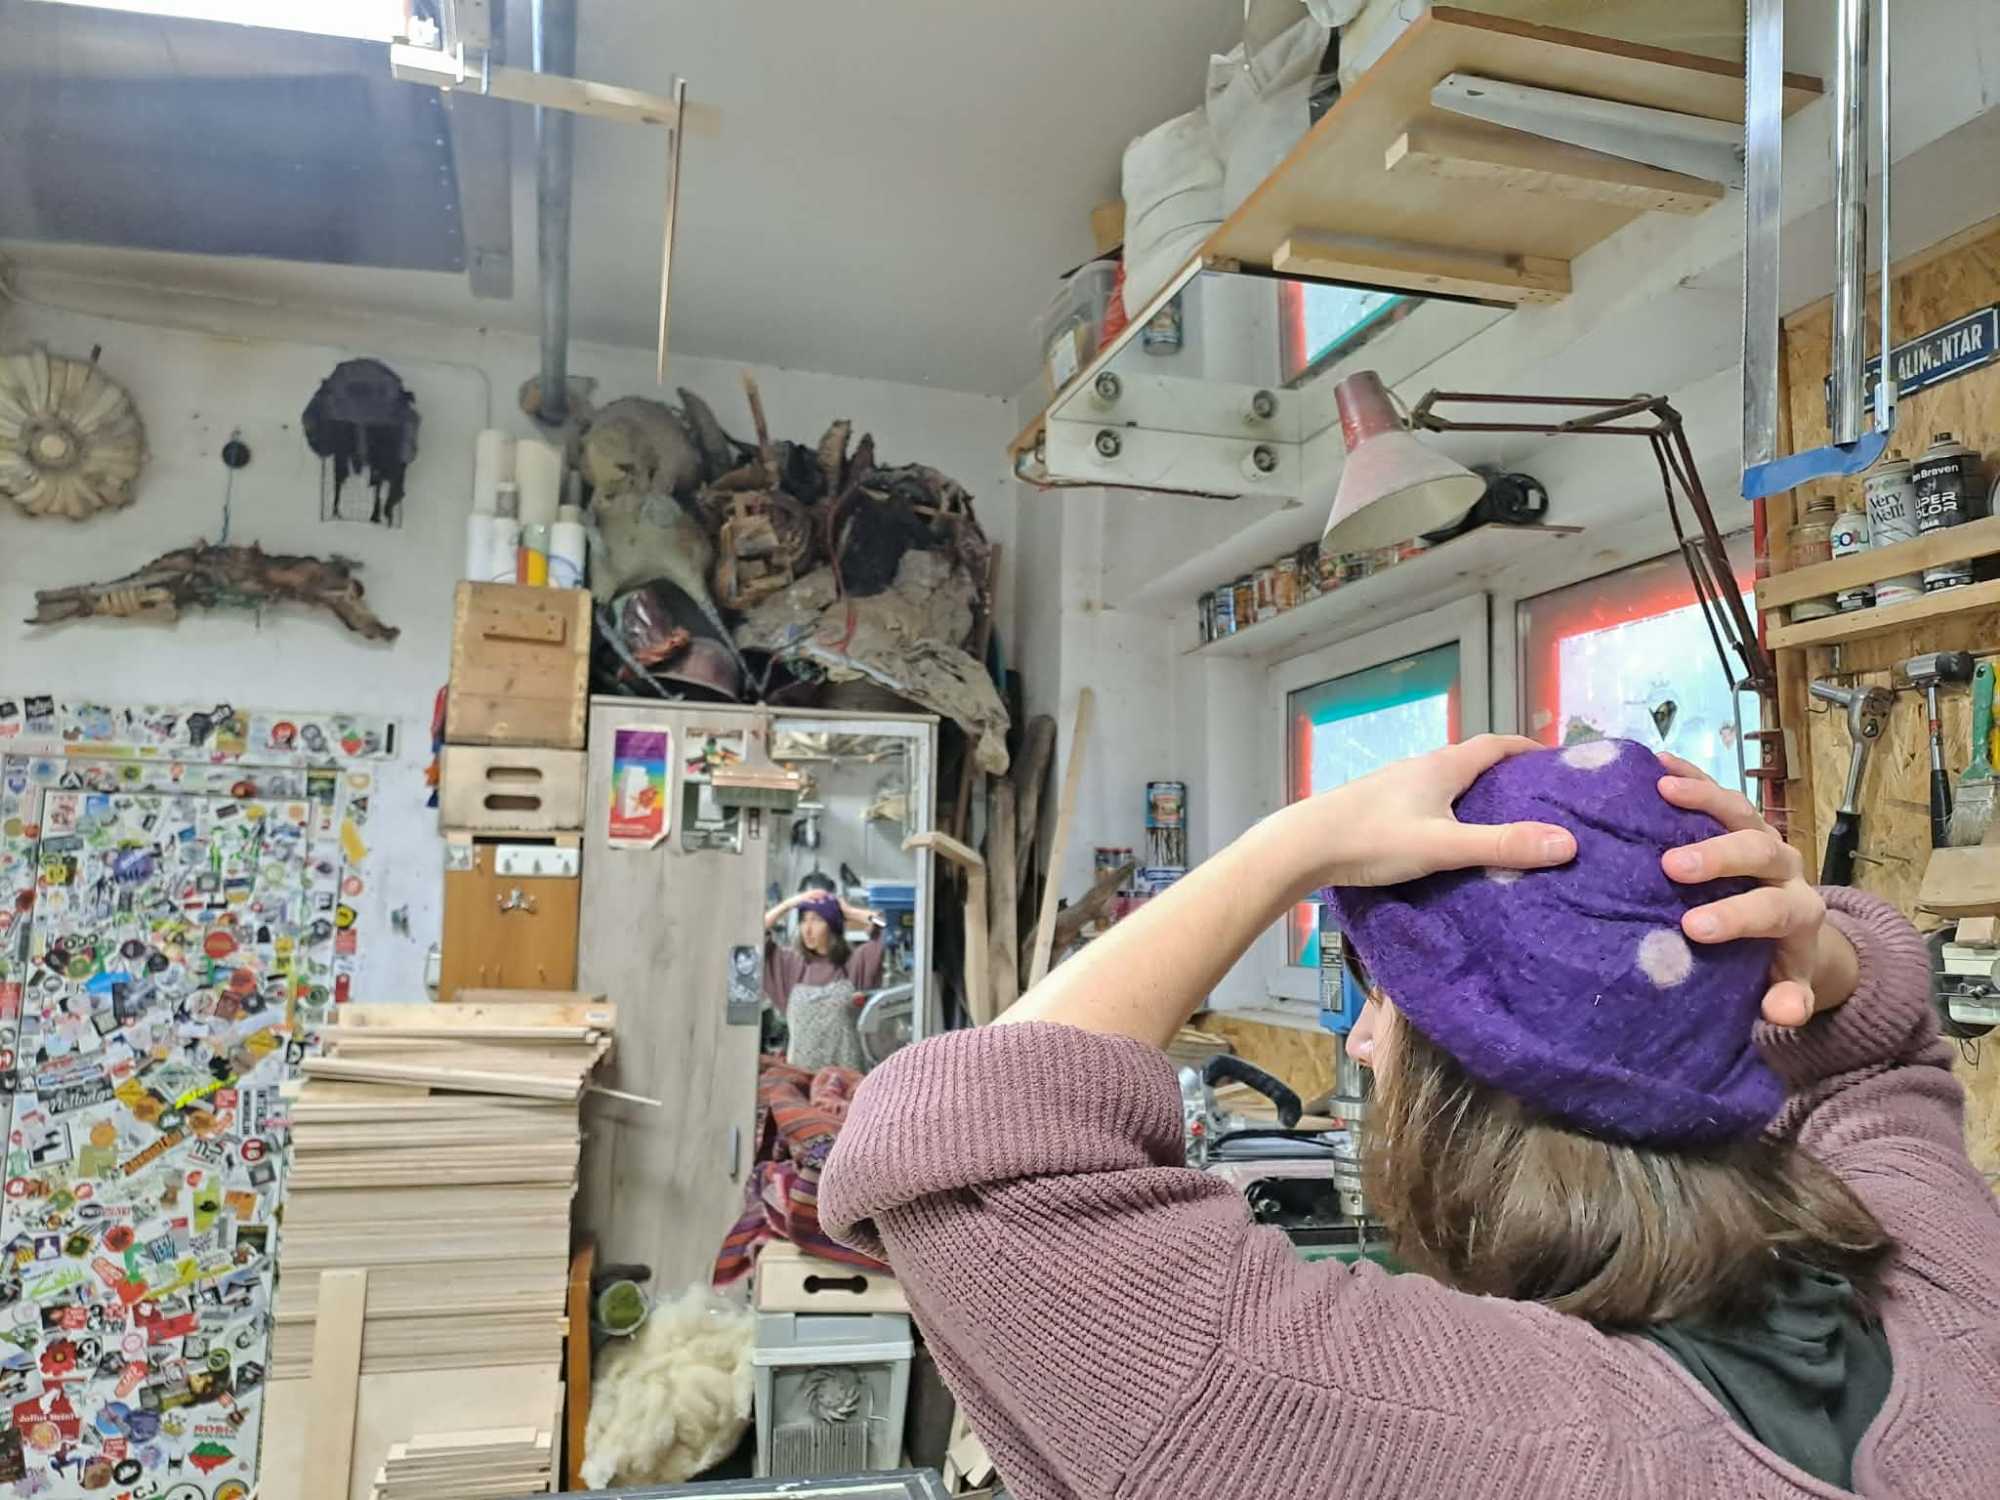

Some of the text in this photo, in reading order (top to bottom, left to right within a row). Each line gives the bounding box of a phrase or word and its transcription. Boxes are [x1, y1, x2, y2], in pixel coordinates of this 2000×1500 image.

[1921, 464, 1958, 478] Braven
[1869, 492, 1902, 509] Very
[1914, 491, 1956, 509] UPER
[1915, 501, 1958, 519] OLOR
